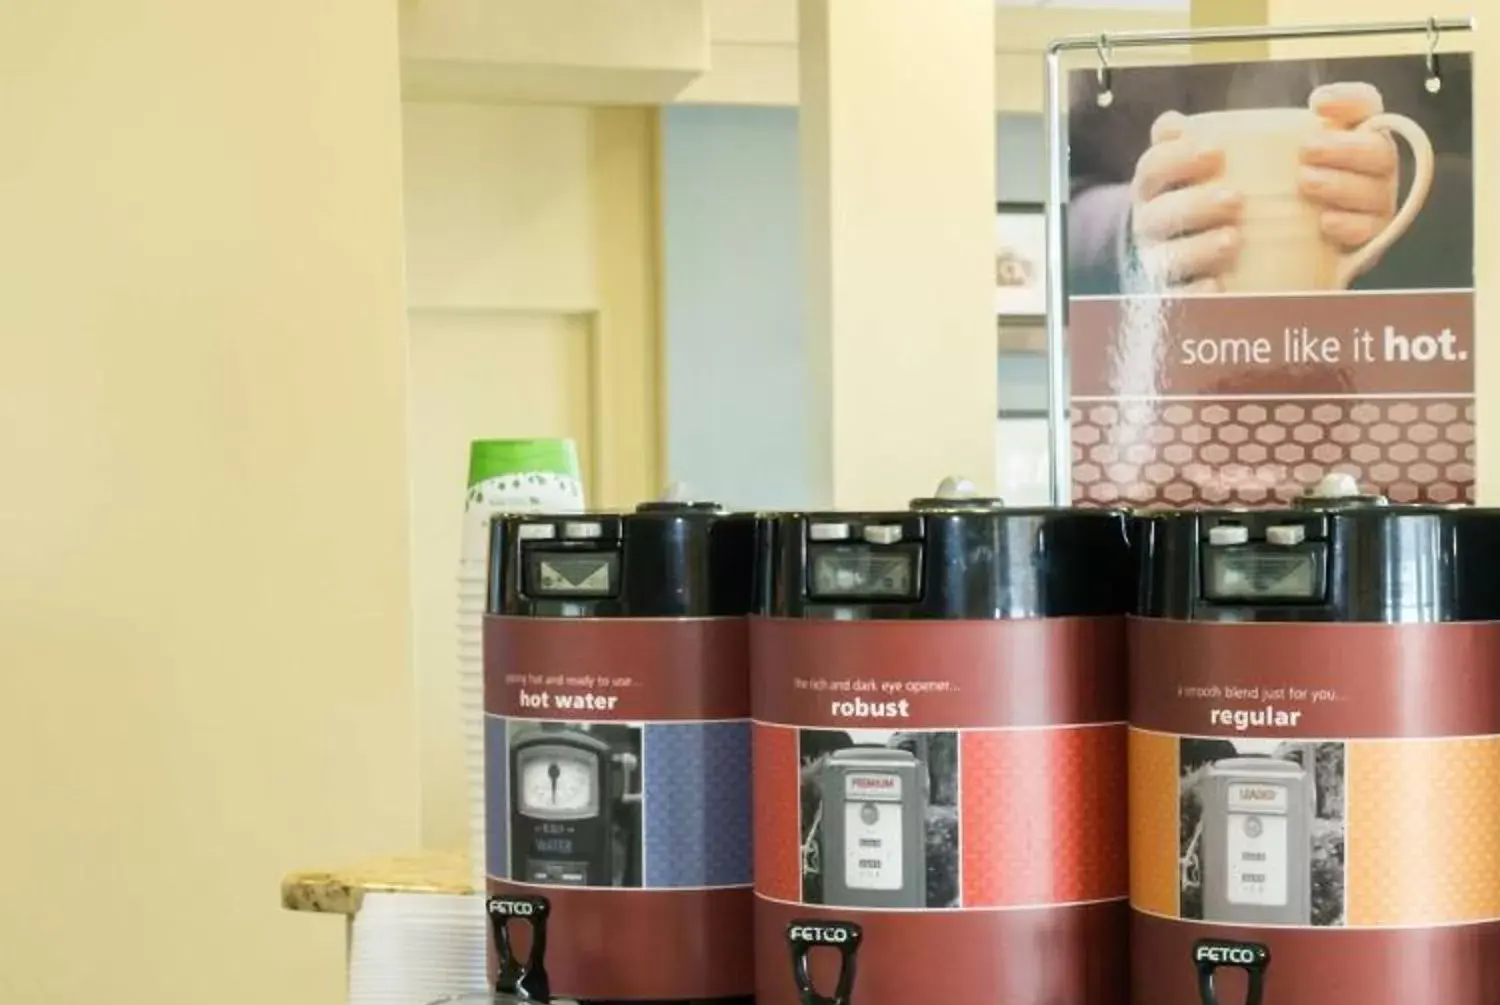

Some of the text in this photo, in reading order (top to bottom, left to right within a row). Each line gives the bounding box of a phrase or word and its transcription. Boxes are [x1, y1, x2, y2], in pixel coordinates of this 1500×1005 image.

[1180, 325, 1468, 365] some like it hot.
[881, 682, 902, 695] eye
[1225, 686, 1259, 700] blend
[1262, 687, 1286, 702] just
[1289, 688, 1308, 700] for
[519, 688, 619, 710] hot water
[831, 696, 909, 718] robust
[1210, 705, 1302, 731] regular
[489, 900, 533, 915] FETCO
[790, 926, 847, 943] FETCO
[1196, 946, 1254, 964] FETCO
